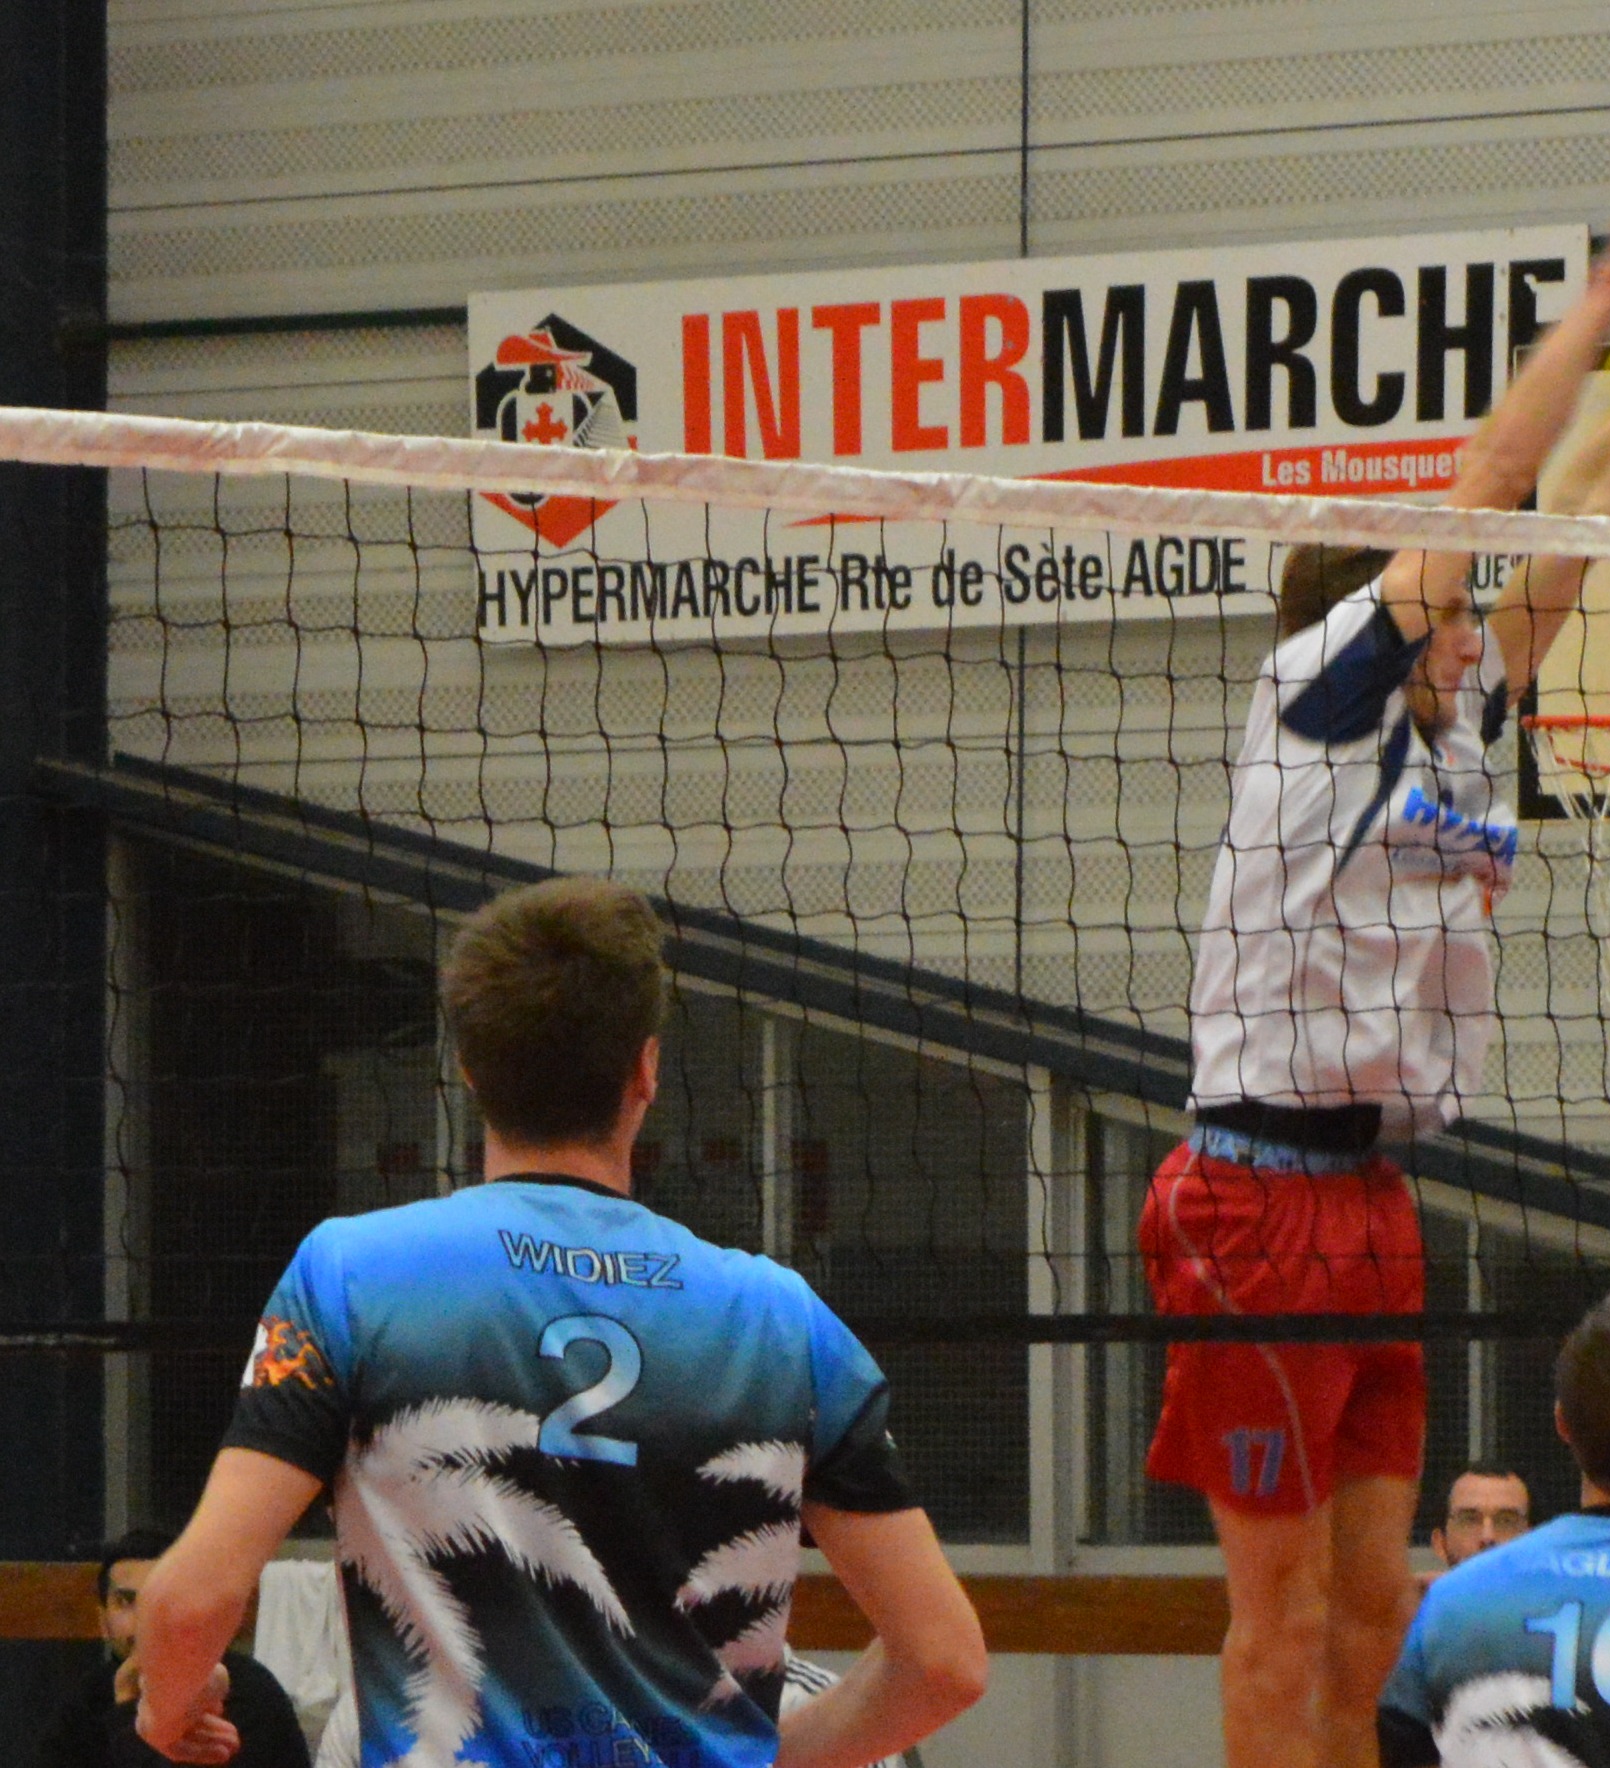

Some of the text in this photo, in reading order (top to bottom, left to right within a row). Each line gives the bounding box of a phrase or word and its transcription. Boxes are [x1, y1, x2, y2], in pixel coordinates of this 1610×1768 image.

[1261, 453, 1313, 487] Les
[478, 554, 822, 628] HYPERMARCHE
[839, 550, 914, 612] Rte
[931, 547, 984, 608] de
[1003, 540, 1105, 603] Sète
[1122, 536, 1248, 597] AGDE
[499, 1228, 684, 1290] WIDIEZ
[538, 1311, 643, 1468] 2
[1222, 1426, 1286, 1497] 17
